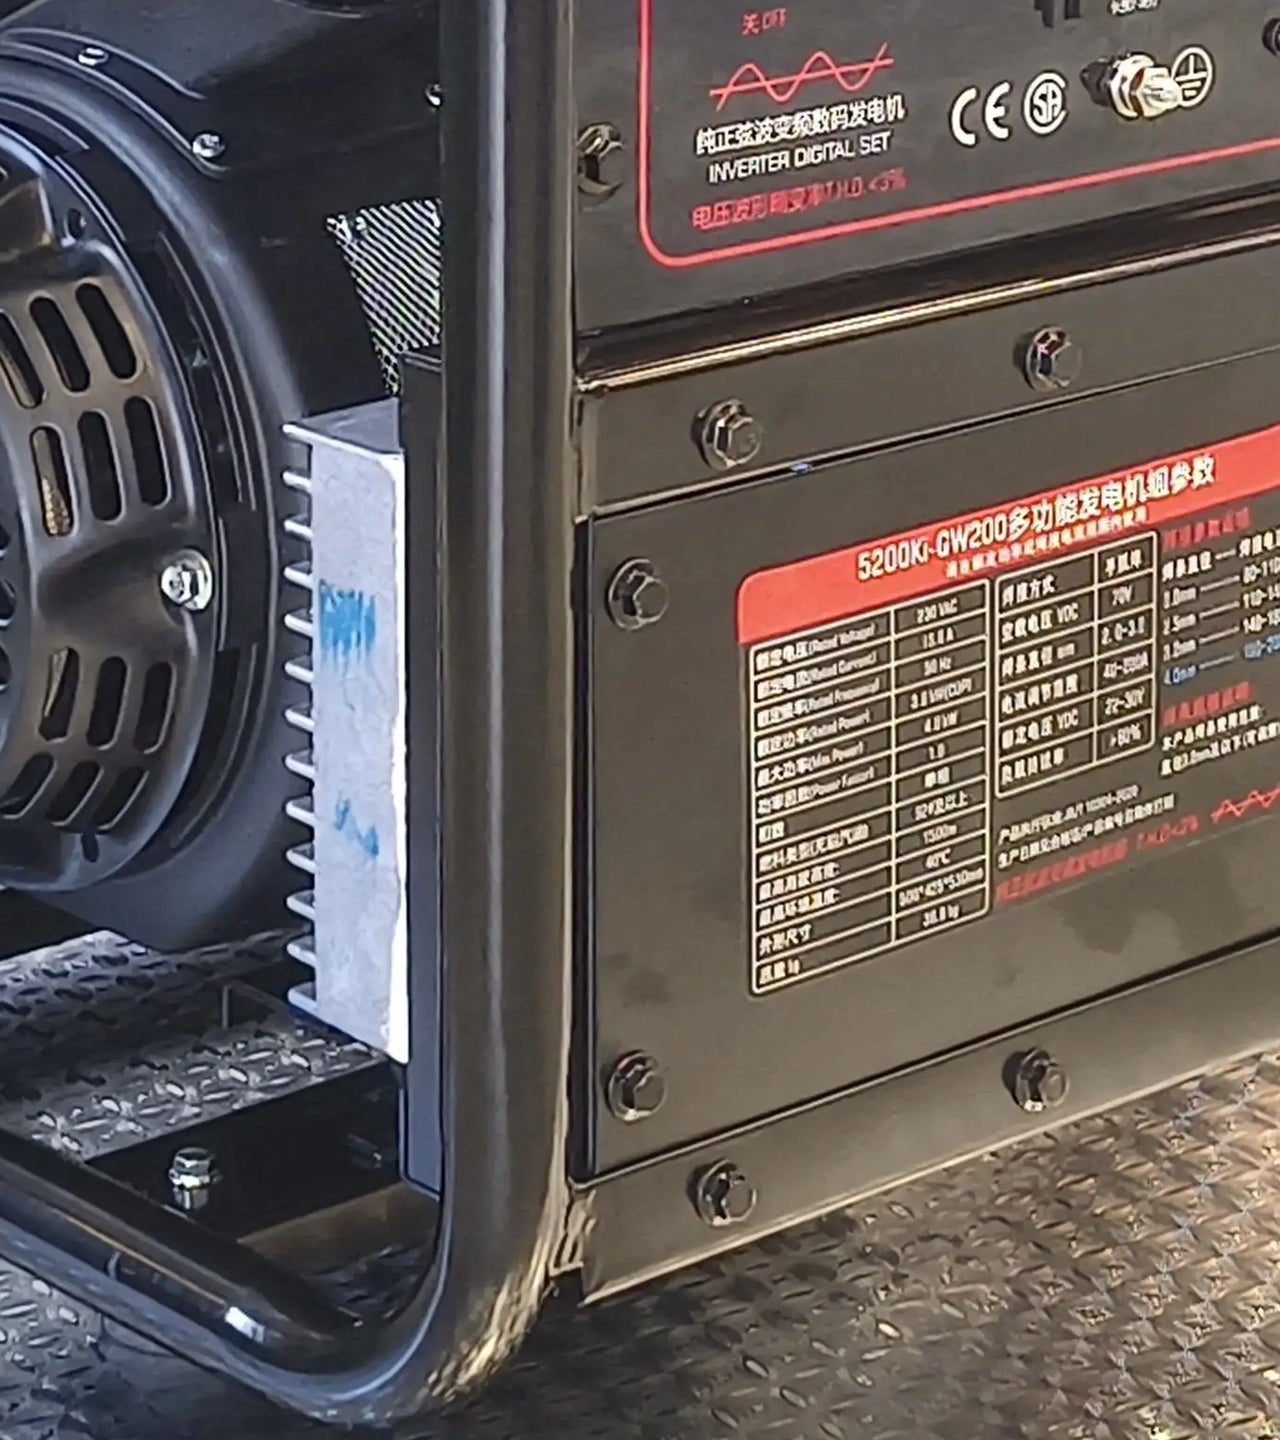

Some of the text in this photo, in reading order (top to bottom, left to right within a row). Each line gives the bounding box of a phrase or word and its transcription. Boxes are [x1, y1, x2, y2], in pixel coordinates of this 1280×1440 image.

[696, 95, 906, 156] 纯正弦波变频数码发电机
[950, 81, 1011, 146] CE
[708, 130, 892, 184] INVERTER DIGITAL SET
